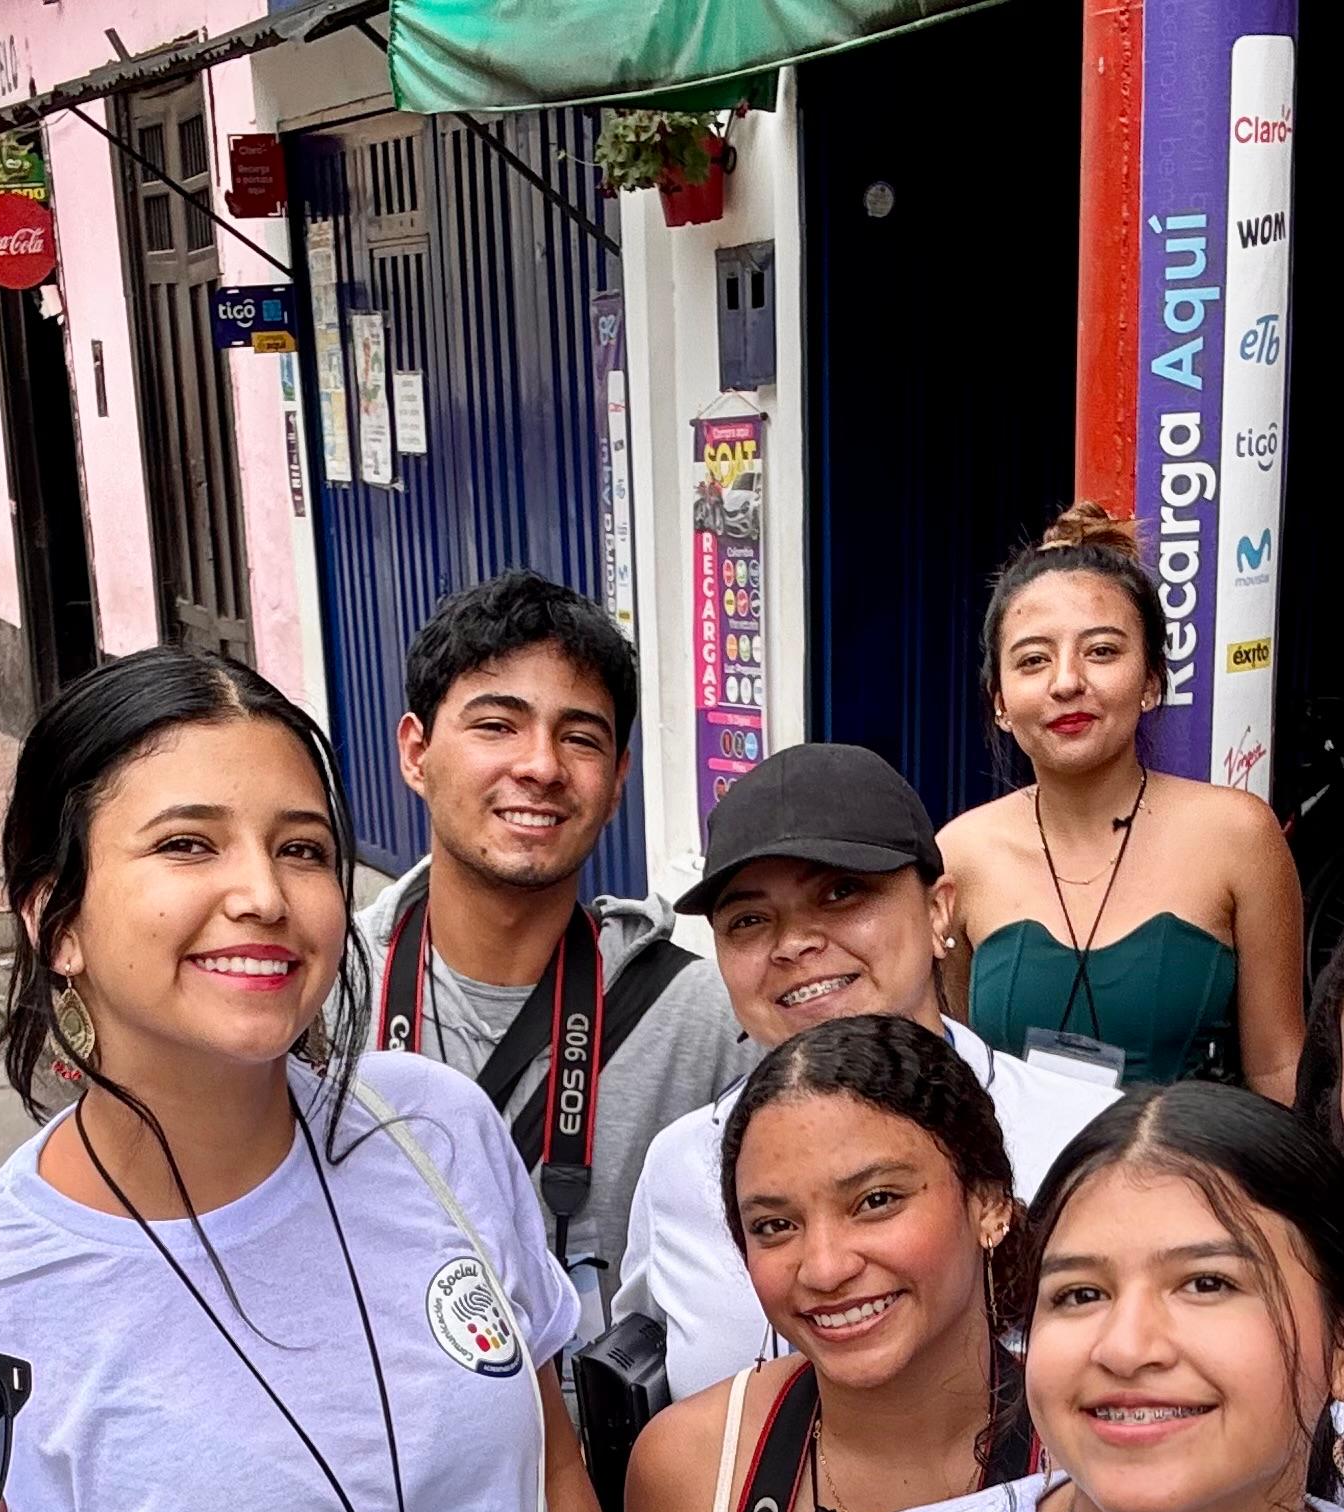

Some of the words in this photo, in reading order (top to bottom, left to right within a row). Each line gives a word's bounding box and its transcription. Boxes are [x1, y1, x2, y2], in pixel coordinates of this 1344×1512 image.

[1234, 113, 1290, 144] Claro
[1237, 211, 1287, 249] WOM
[1148, 213, 1221, 391] Aquí
[704, 440, 757, 488] SOAT
[1158, 411, 1218, 706] Recarga
[701, 532, 718, 707] RECARGAS
[1232, 642, 1270, 668] éxito
[564, 1012, 590, 1062] 90D
[560, 1068, 586, 1136] EOS
[437, 1264, 479, 1297] Social
